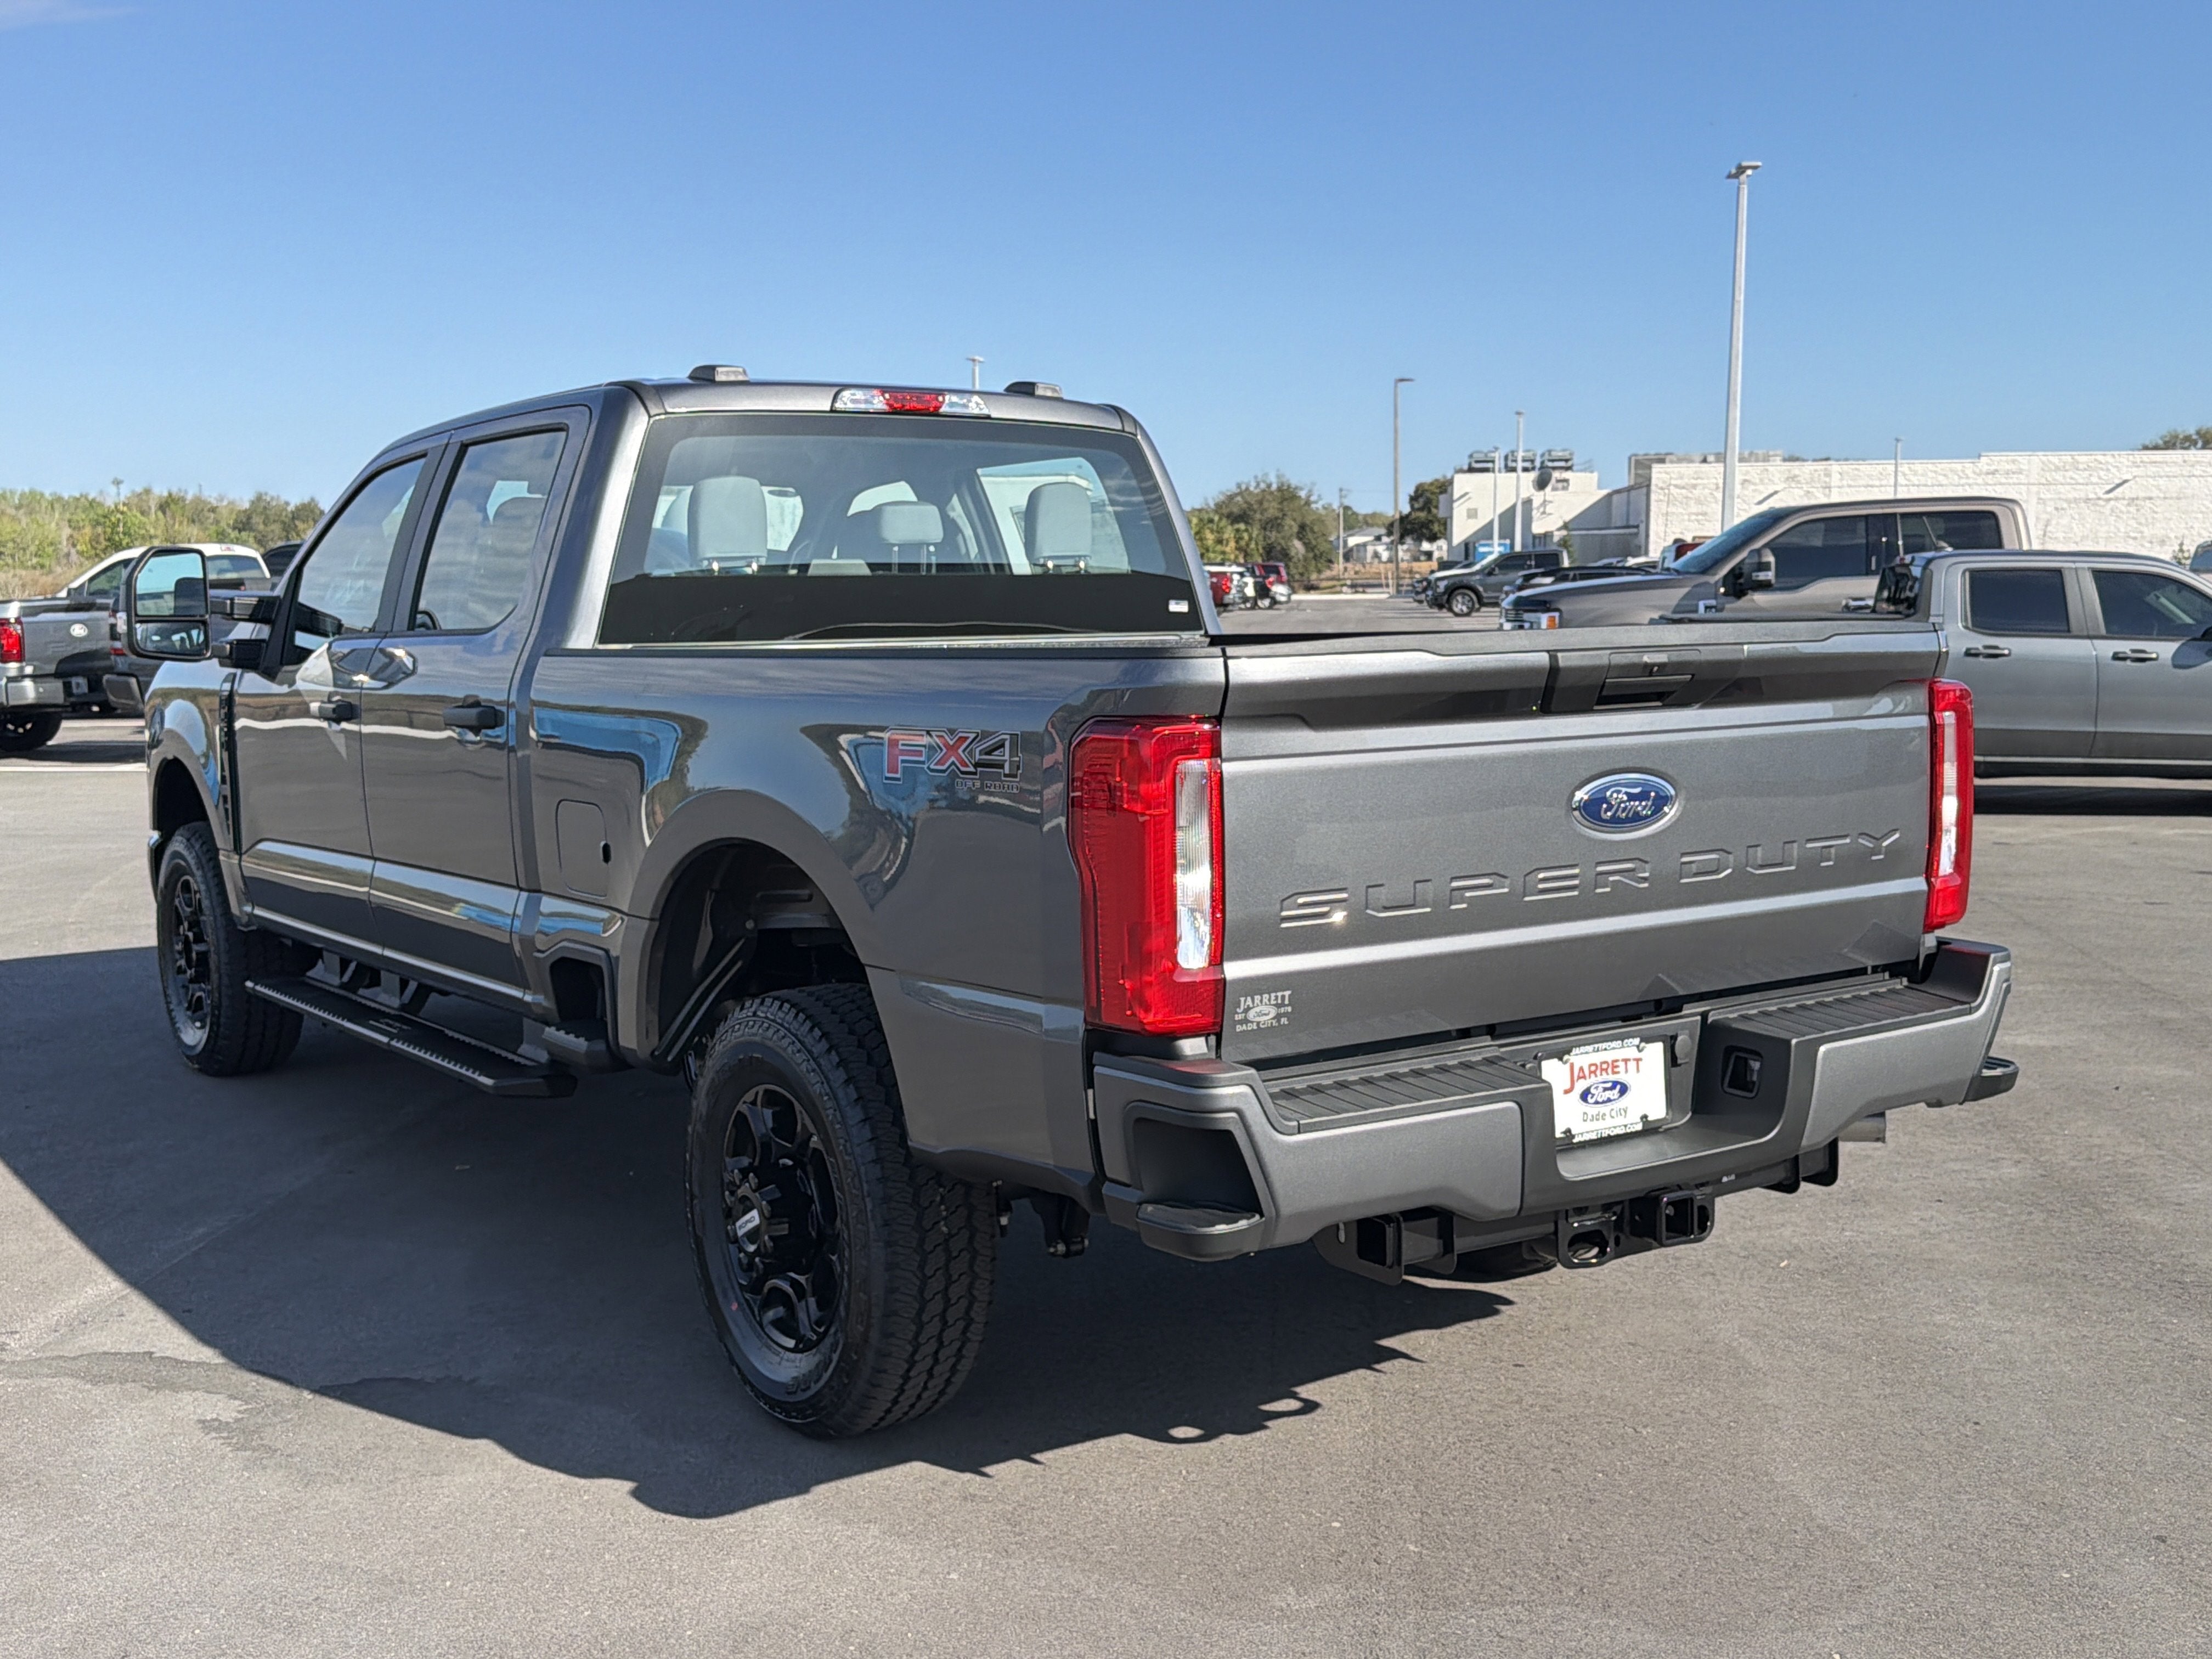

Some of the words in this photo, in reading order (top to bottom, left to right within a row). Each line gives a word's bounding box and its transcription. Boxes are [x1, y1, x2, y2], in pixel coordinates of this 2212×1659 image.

[884, 727, 1022, 783] FX4
[955, 779, 981, 790] OFF
[984, 781, 1020, 793] ROAD
[1601, 787, 1655, 820] Ford
[1280, 856, 1649, 928] SUPER
[1679, 828, 1900, 883] DUTY
[1236, 990, 1291, 1013] JARRETT
[1236, 1022, 1257, 1032] DADE
[1563, 1058, 1643, 1095] JARRETT
[1587, 1082, 1621, 1103] Ford
[1582, 1110, 1606, 1122] Dade
[1610, 1106, 1628, 1119] City
